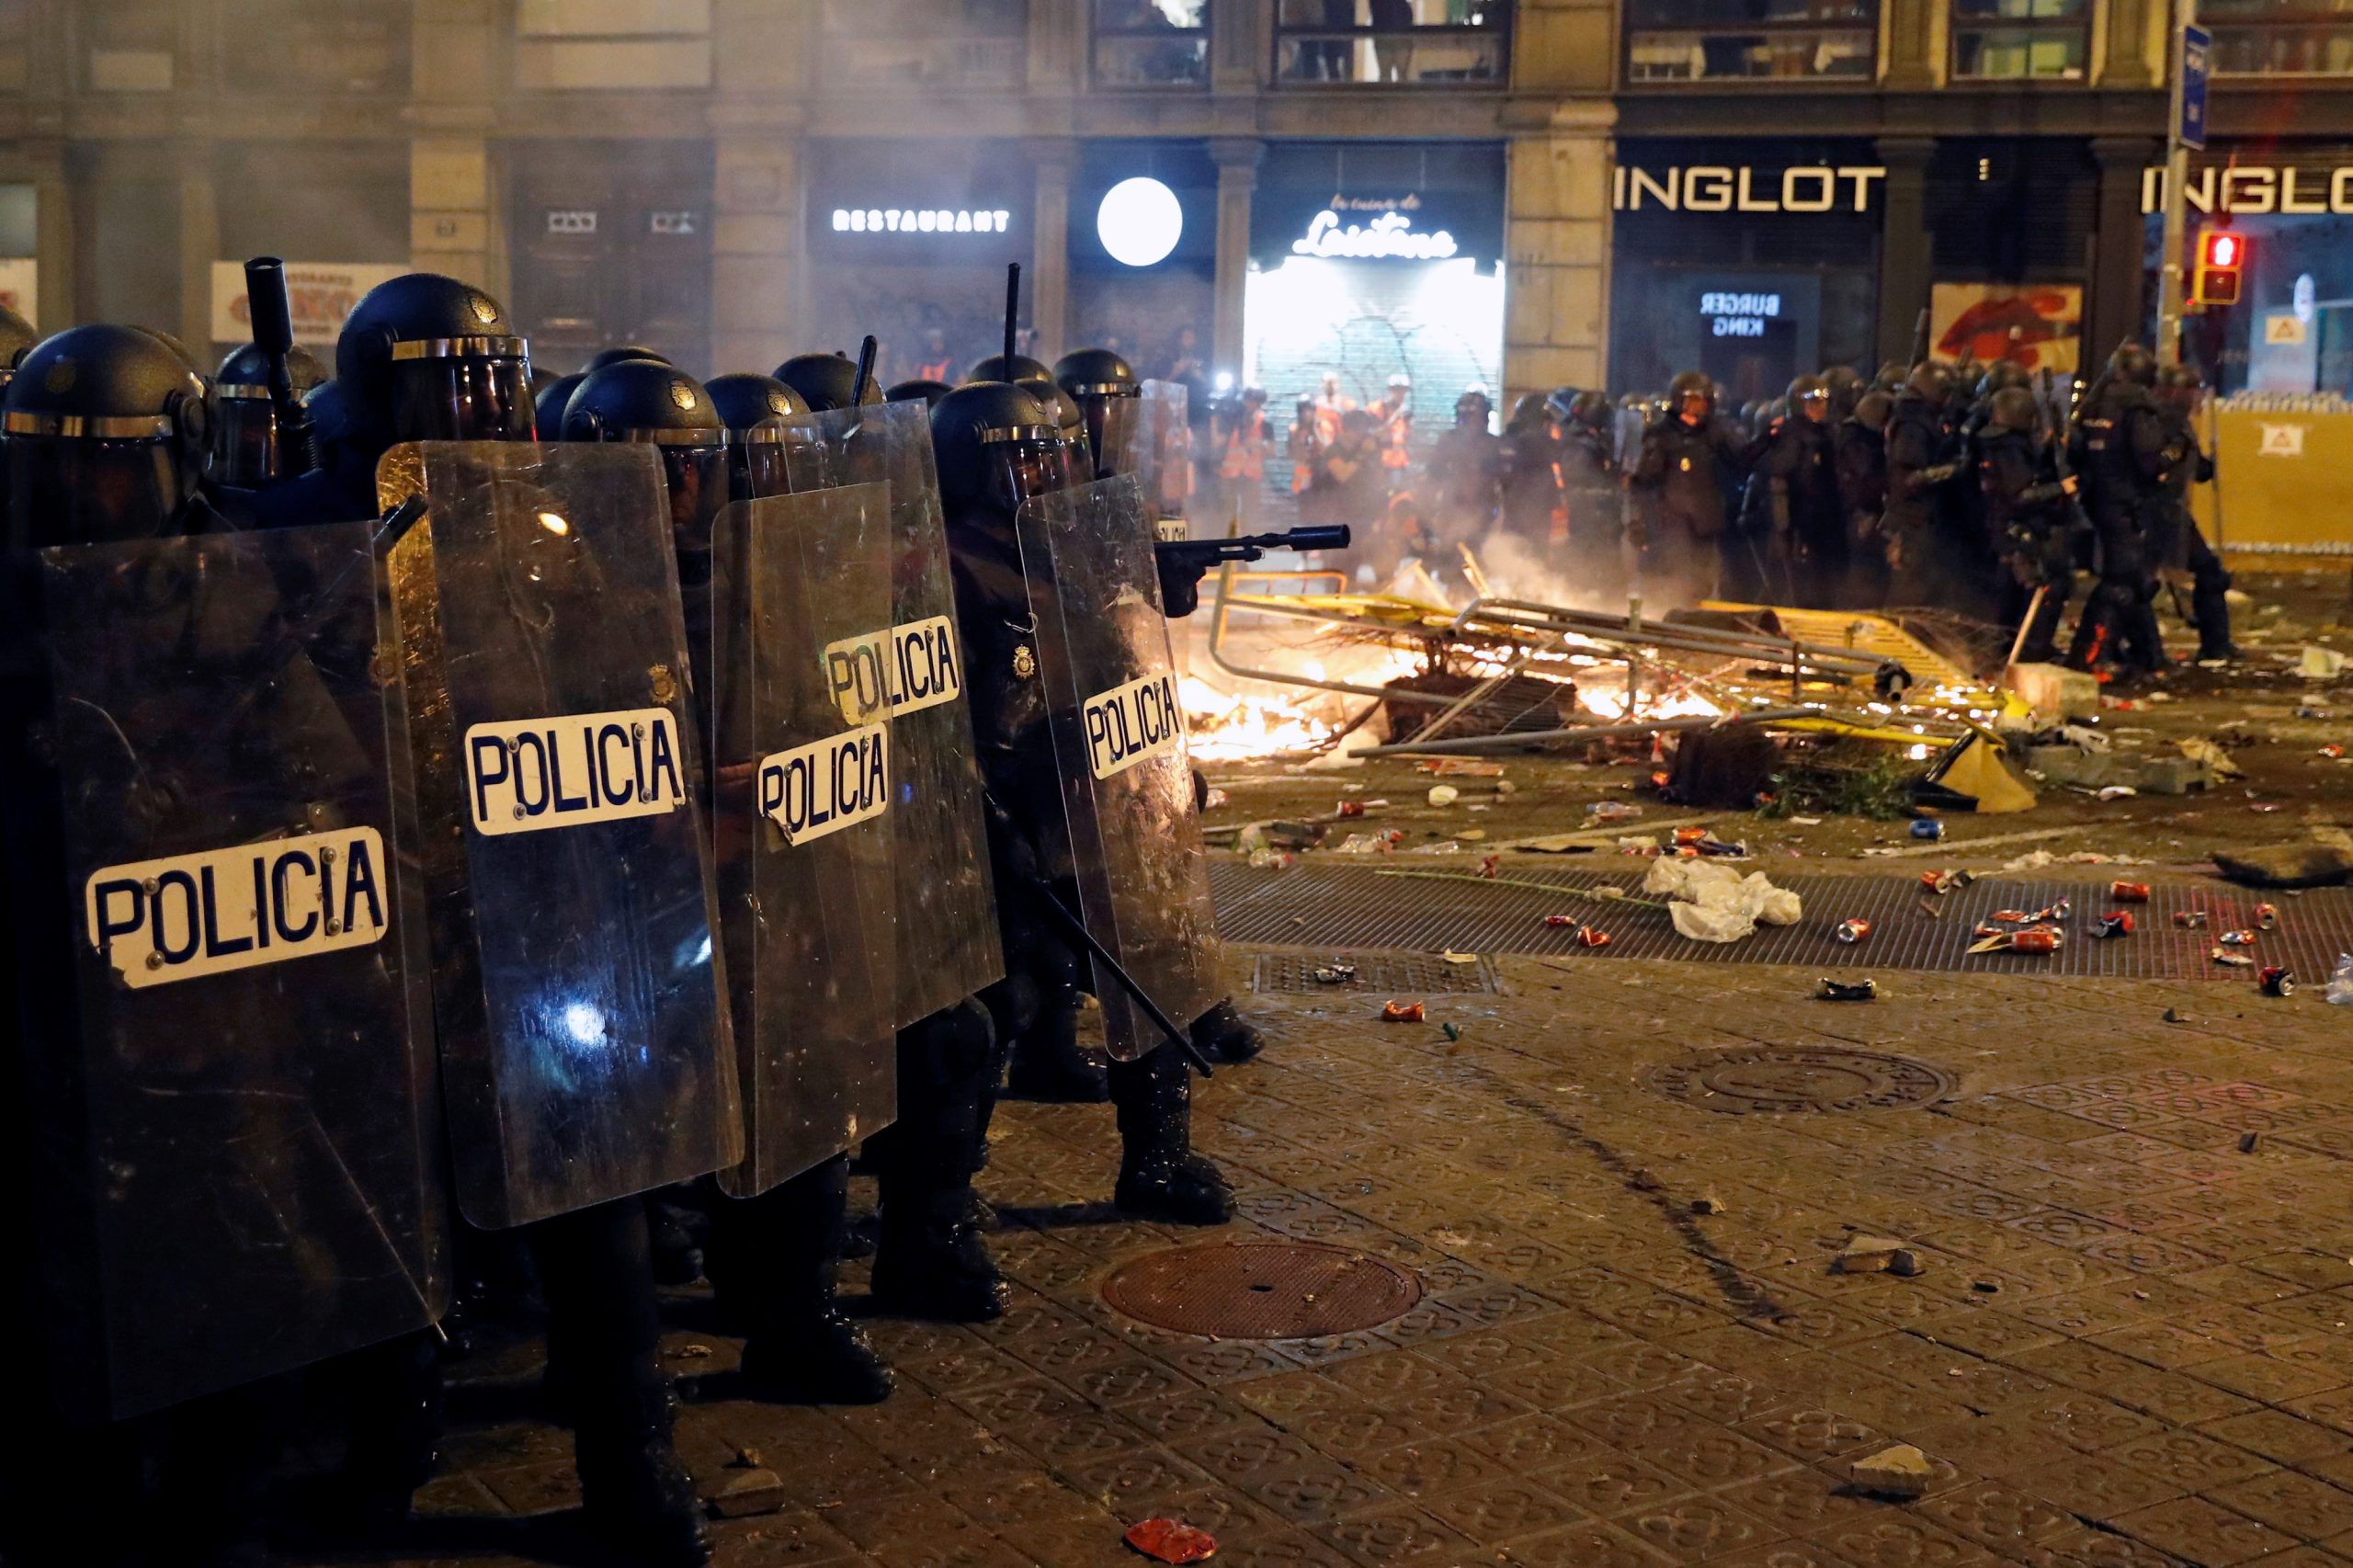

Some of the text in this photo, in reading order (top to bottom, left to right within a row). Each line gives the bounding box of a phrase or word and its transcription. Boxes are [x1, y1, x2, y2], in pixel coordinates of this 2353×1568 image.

[833, 210, 1010, 232] RESTAURANT
[1613, 166, 1887, 212] INGLOT
[828, 626, 958, 713] POLICIA
[1086, 676, 1180, 770] POLICIA
[472, 720, 682, 822] POLICIA
[763, 733, 886, 834] POLICIA
[95, 839, 384, 968] POLICIA
